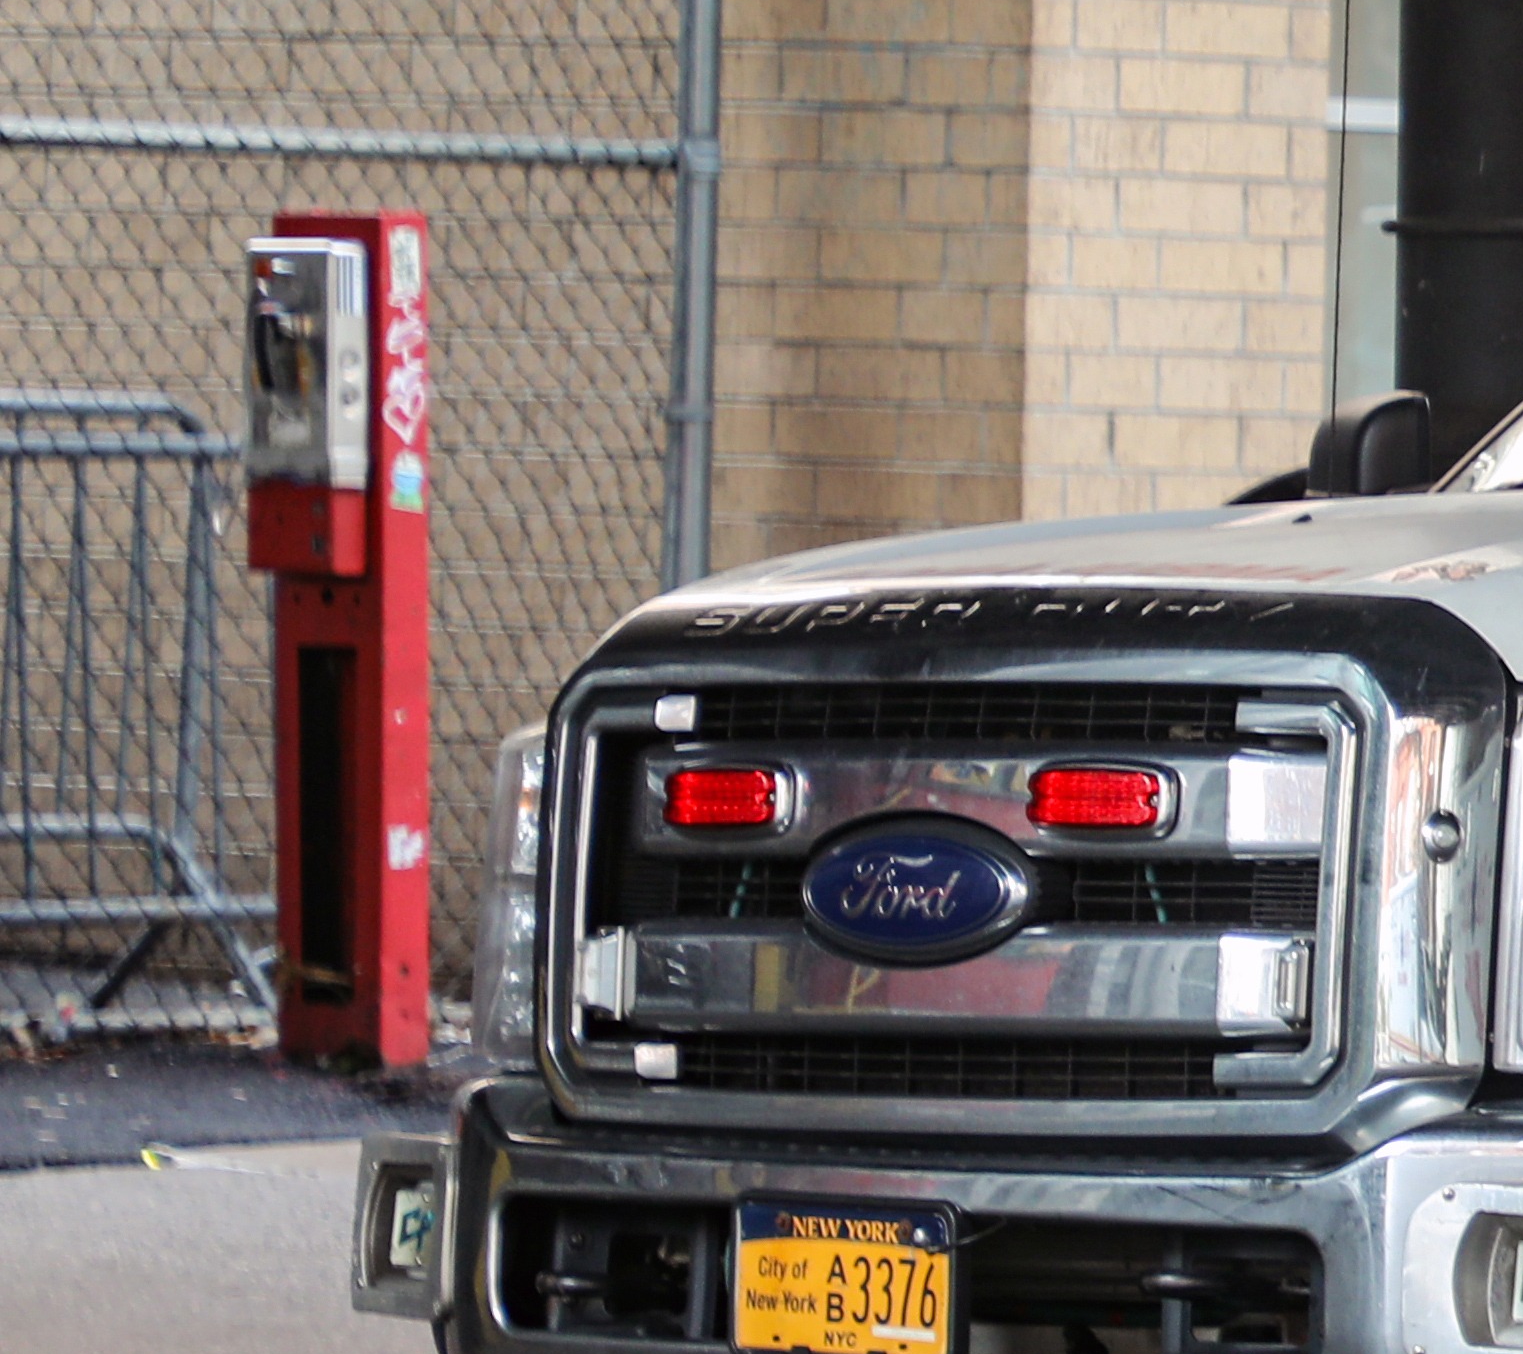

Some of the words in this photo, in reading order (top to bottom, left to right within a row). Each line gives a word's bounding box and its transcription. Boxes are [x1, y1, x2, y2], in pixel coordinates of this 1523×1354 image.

[840, 852, 961, 919] Ford
[792, 1215, 840, 1238] NEW
[845, 1219, 900, 1244] YORK
[758, 1255, 787, 1282] City
[792, 1258, 808, 1279] of
[746, 1288, 778, 1311] New
[783, 1289, 817, 1314] York
[823, 1330, 857, 1347] NYC
